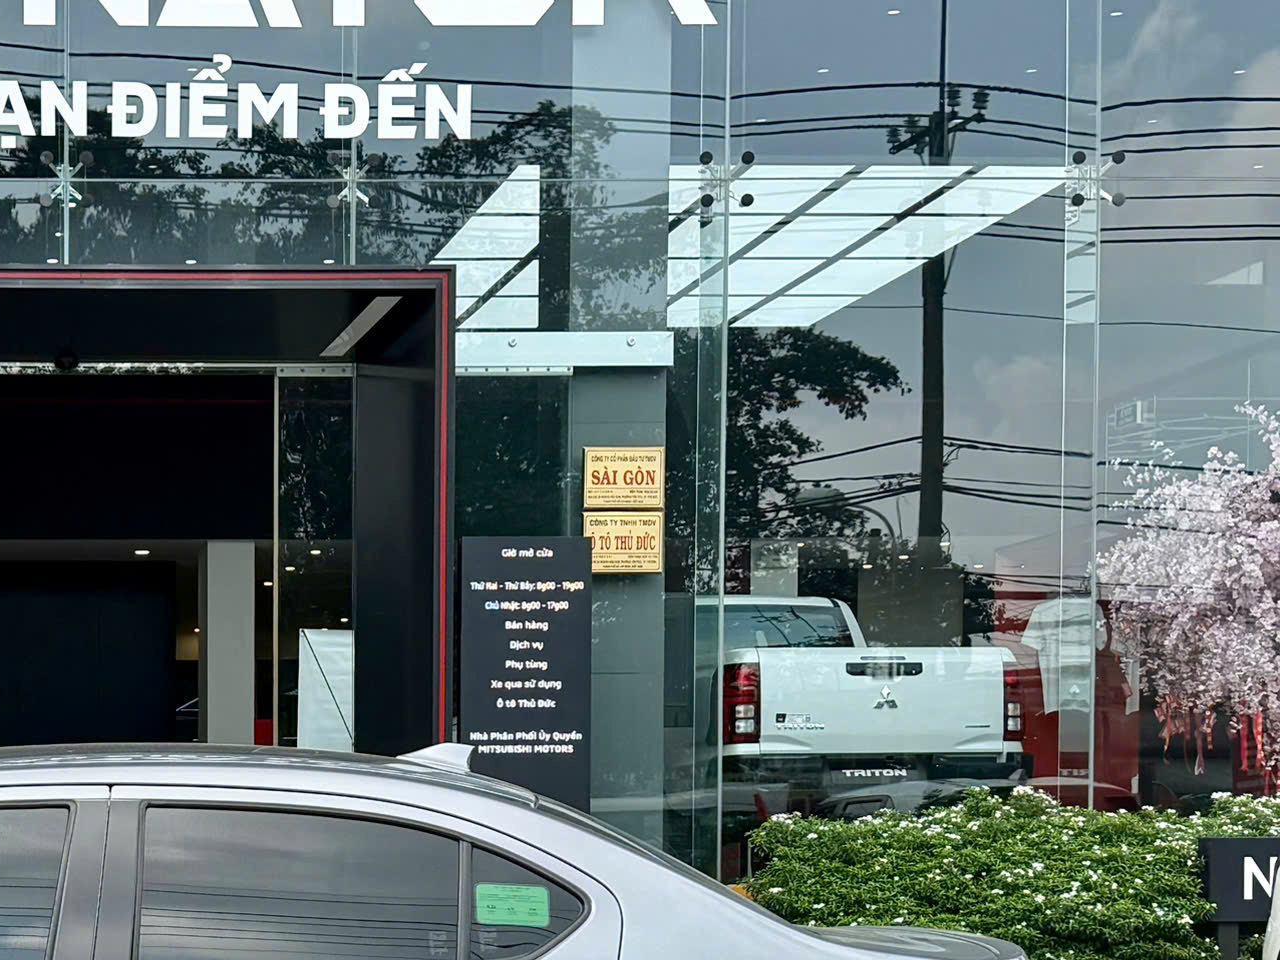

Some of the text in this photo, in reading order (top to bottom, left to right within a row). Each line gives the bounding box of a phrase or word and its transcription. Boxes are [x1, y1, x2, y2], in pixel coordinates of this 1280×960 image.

[107, 53, 298, 140] ĐIỂM
[319, 62, 472, 140] ĐẾN
[591, 466, 656, 485] SÀI GÒN
[615, 530, 633, 550] THỦ
[636, 531, 656, 550] ĐỨC
[505, 621, 548, 631] Bán hàng
[510, 640, 544, 651] Dịch vụ
[505, 660, 548, 671] Phụ tùng
[491, 680, 502, 689] Xe
[505, 681, 522, 690] qua
[538, 680, 562, 690] dụng
[518, 699, 536, 708] Thủ
[478, 745, 574, 753] MITSUBISHI MOTORS
[842, 769, 907, 777] TRITON
